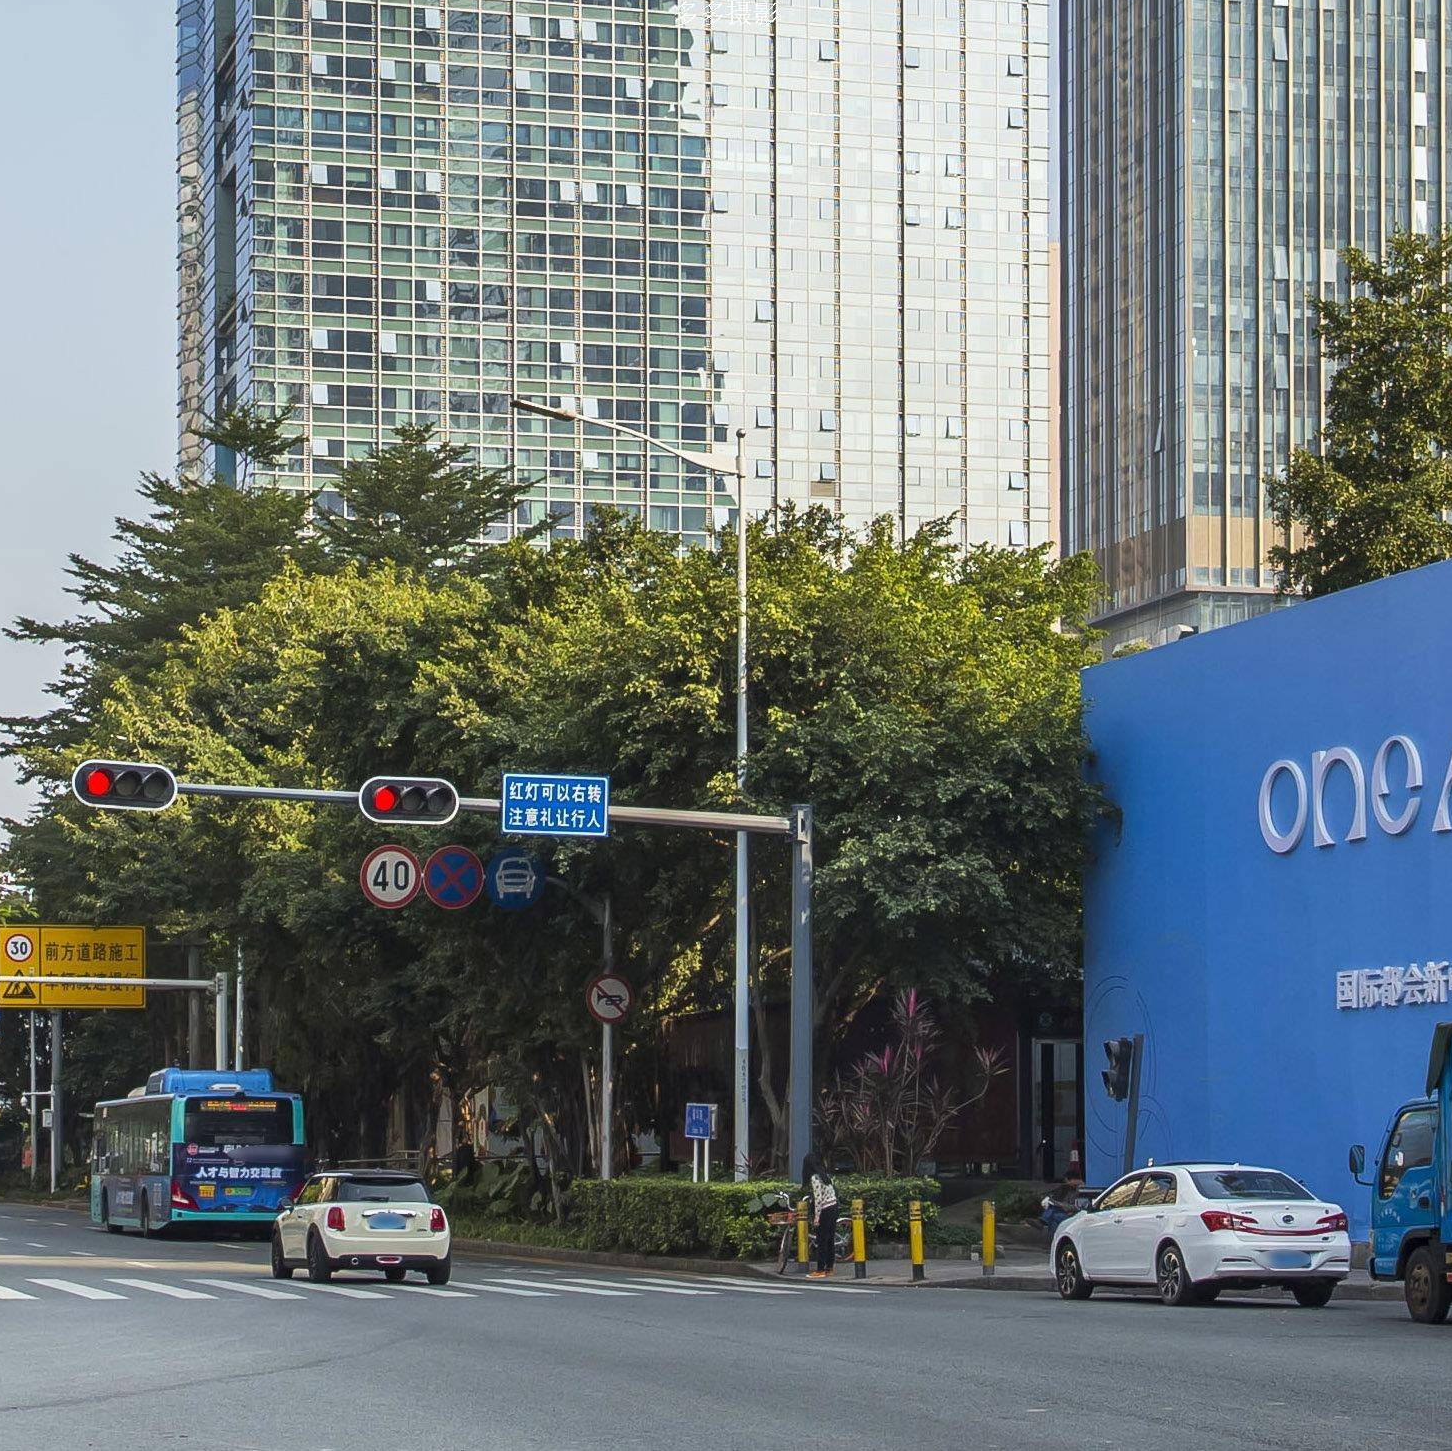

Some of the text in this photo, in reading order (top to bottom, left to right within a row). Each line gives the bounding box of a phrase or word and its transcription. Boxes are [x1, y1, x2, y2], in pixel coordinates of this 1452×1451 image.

[508, 781, 602, 804] 红灯可以右转
[507, 806, 602, 829] 注意礼让行人
[372, 860, 410, 891] 40
[10, 941, 28, 956] 30
[45, 942, 138, 962] 前方道路施工
